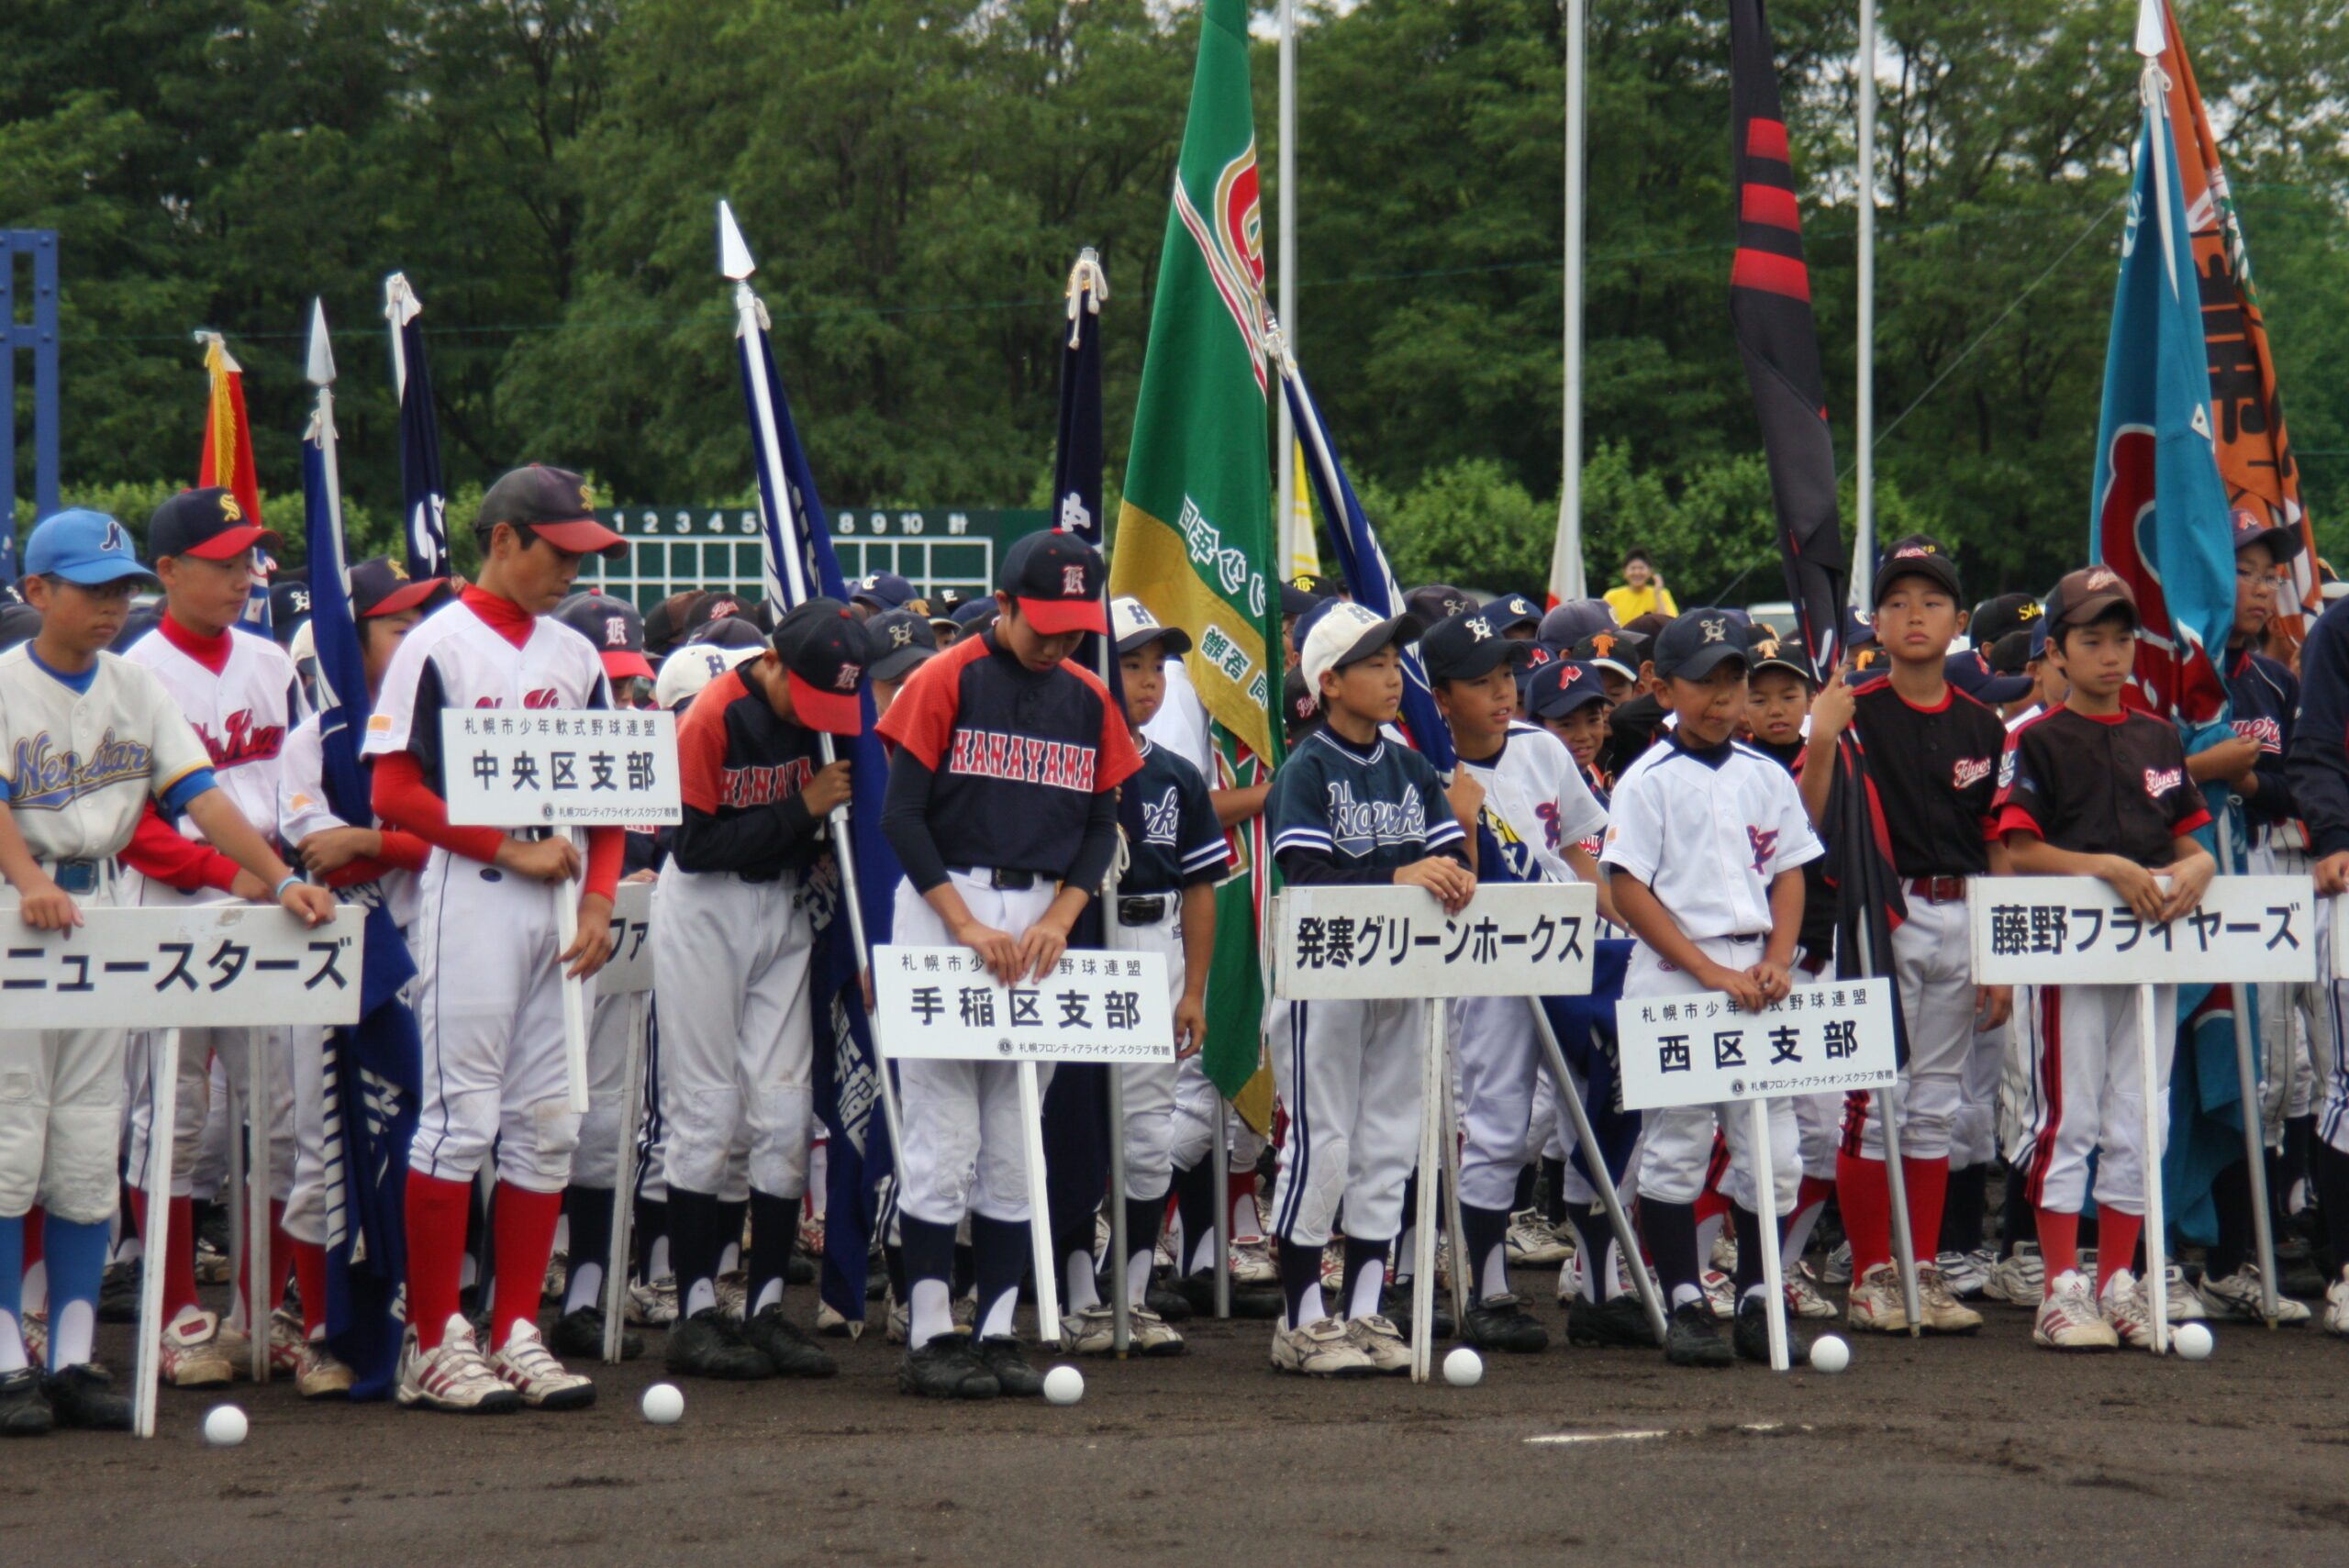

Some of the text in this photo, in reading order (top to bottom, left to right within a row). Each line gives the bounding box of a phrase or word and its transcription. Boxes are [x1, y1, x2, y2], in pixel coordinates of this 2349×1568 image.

[613, 512, 625, 533] 1
[643, 511, 659, 533] 2
[675, 511, 691, 533] 3
[707, 511, 725, 533] 4
[741, 512, 757, 533] 5
[839, 512, 855, 534] 8
[871, 513, 886, 534] 9
[900, 513, 923, 534] 10
[464, 717, 656, 737] 札幌市少年軟式野球連盟
[473, 750, 656, 791] 中央区支部
[949, 728, 1097, 794] KANAYAMA
[1297, 915, 1584, 970] 発寒グリーンホークス
[1990, 901, 2300, 956] 藤野フライヤーズ
[2, 937, 352, 993] ニュースターズ
[902, 953, 1141, 976] 札幌市少野球連盟
[911, 986, 1141, 1030] 手稲区支部
[1642, 988, 1867, 1023] 札幌市少年式野球連盟
[1658, 1019, 1859, 1073] 西区支部
